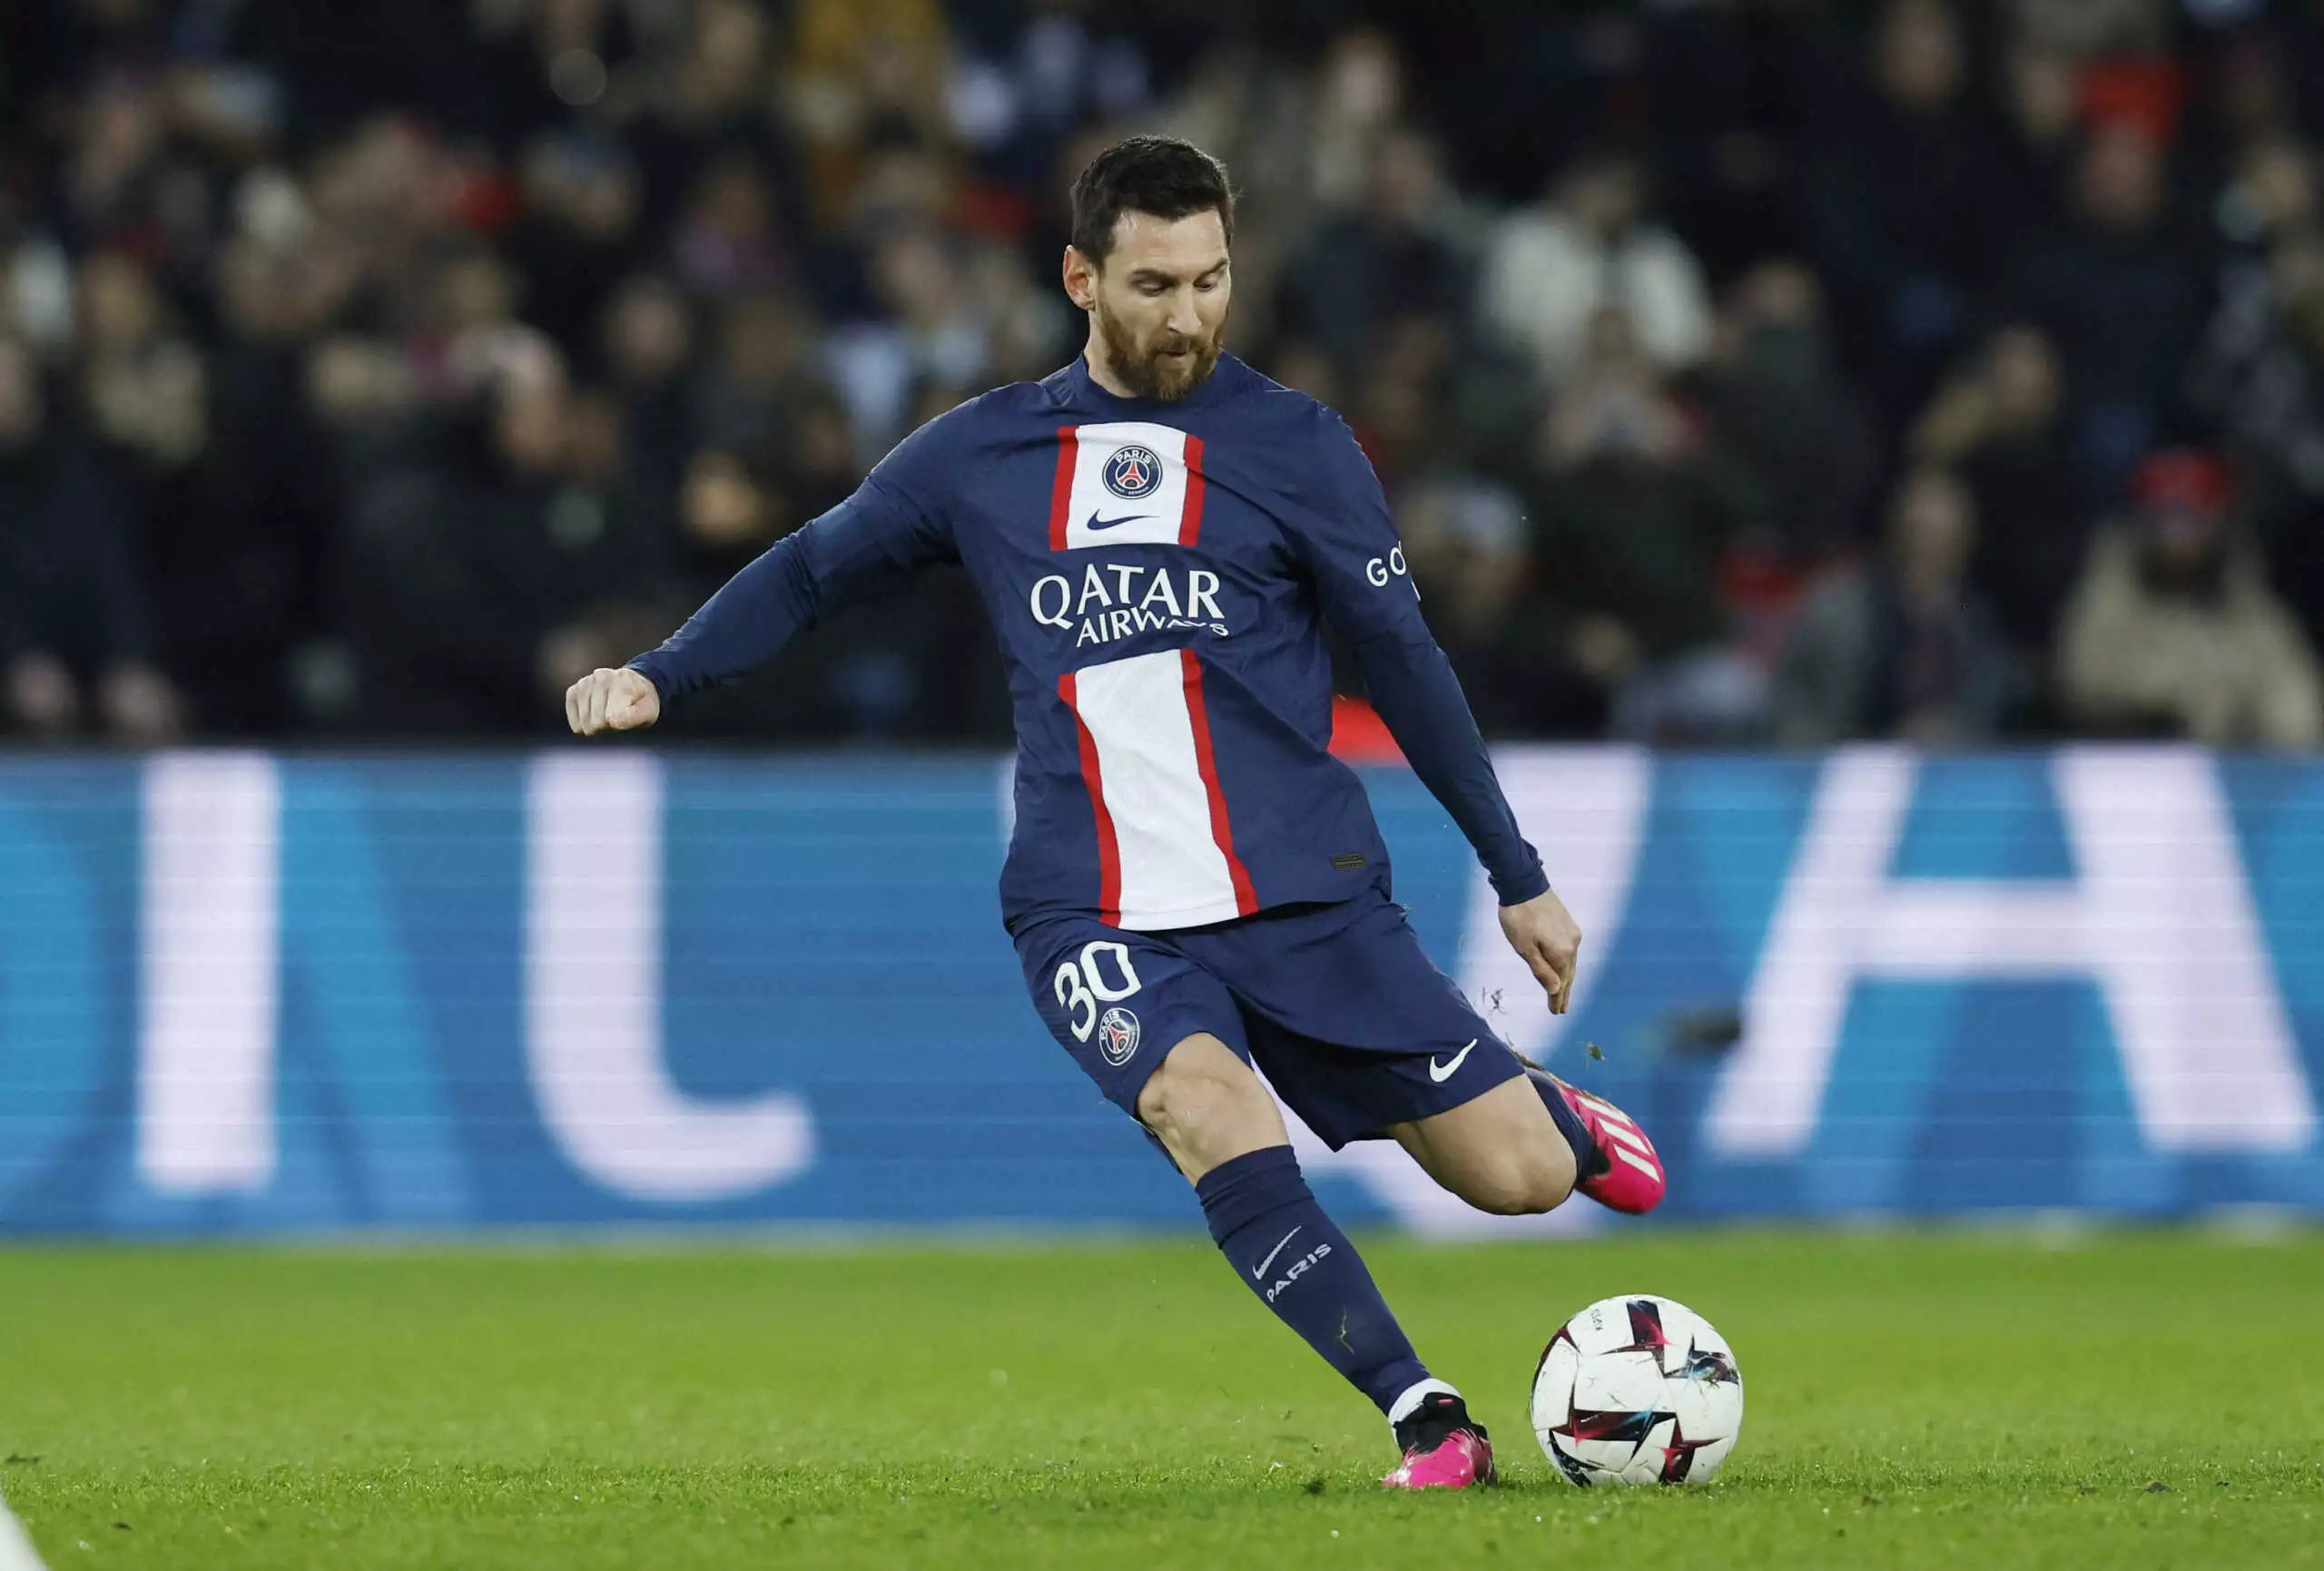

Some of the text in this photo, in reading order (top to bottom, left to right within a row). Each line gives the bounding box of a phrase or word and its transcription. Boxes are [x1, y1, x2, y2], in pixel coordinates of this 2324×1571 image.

[1115, 449, 1152, 464] PARIS
[1365, 540, 1407, 588] GO
[1030, 564, 1226, 630] QATAR
[1054, 940, 1142, 1043] 30
[1266, 1243, 1332, 1303] PARIS
